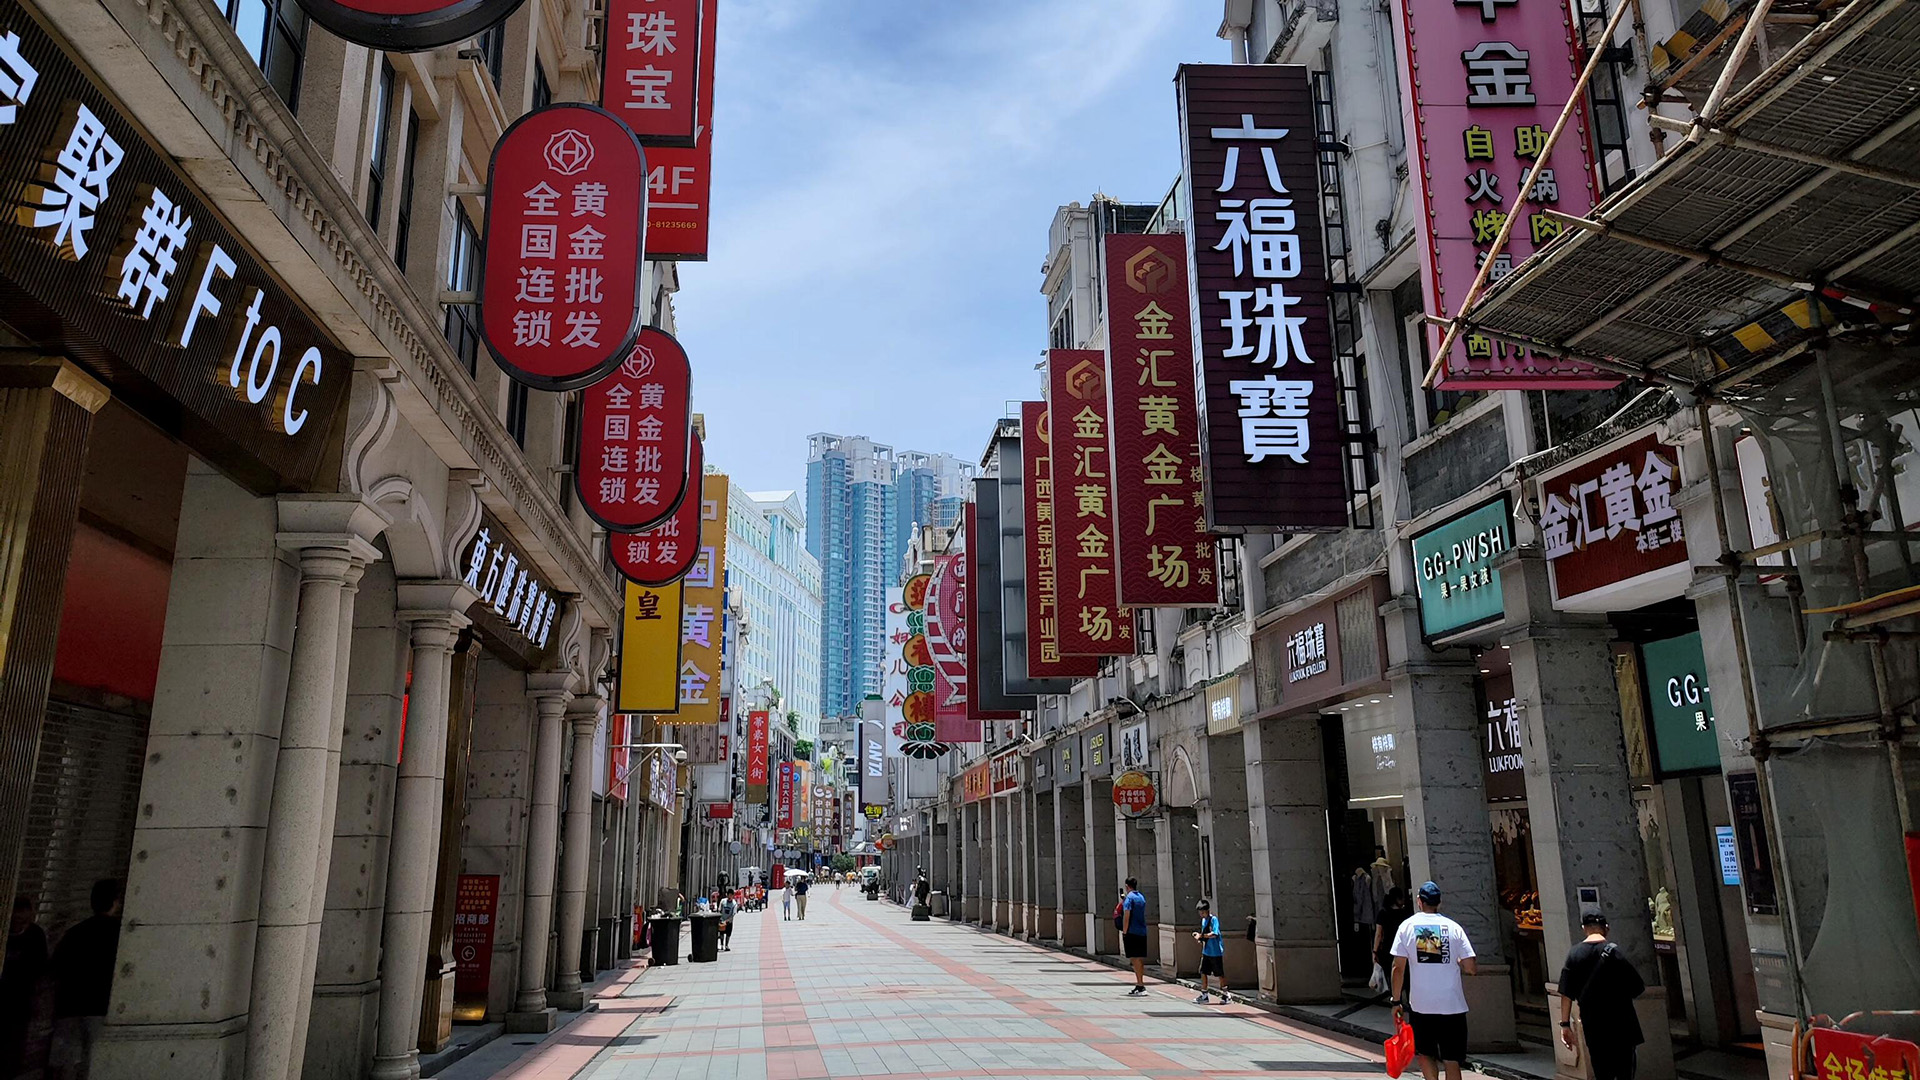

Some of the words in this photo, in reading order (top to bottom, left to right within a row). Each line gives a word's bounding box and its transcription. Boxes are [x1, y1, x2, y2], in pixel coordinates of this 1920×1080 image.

[625, 11, 677, 110] 珠宝
[1456, 0, 1536, 105] 金
[648, 165, 696, 195] 4F
[1466, 125, 1550, 160] 自助
[1468, 168, 1558, 203] 火锅
[512, 181, 562, 348] 全国连锁
[561, 182, 609, 348] 黄金批发
[1473, 210, 1562, 244] 烤肉
[1210, 114, 1315, 464] 六福珠寶
[180, 244, 237, 349] F
[284, 347, 322, 436] C
[599, 383, 633, 505] 全国连锁
[633, 384, 666, 505] 黄金批发
[1134, 301, 1190, 588] 金汇黄金广场
[655, 514, 680, 565] 批发
[1072, 405, 1113, 641] 金汇黄金广场
[1190, 443, 1213, 585] 二楼黄金批发
[1539, 451, 1677, 560] 金汇黄金
[1636, 519, 1682, 554] 本座二楼
[1423, 526, 1501, 580] GG-PWSH
[1441, 566, 1489, 599] 果一果女孩
[635, 590, 662, 620] 皇
[1286, 622, 1325, 670] 六福珠寶
[869, 739, 883, 777] ANTA
[1488, 698, 1521, 753] 六福
